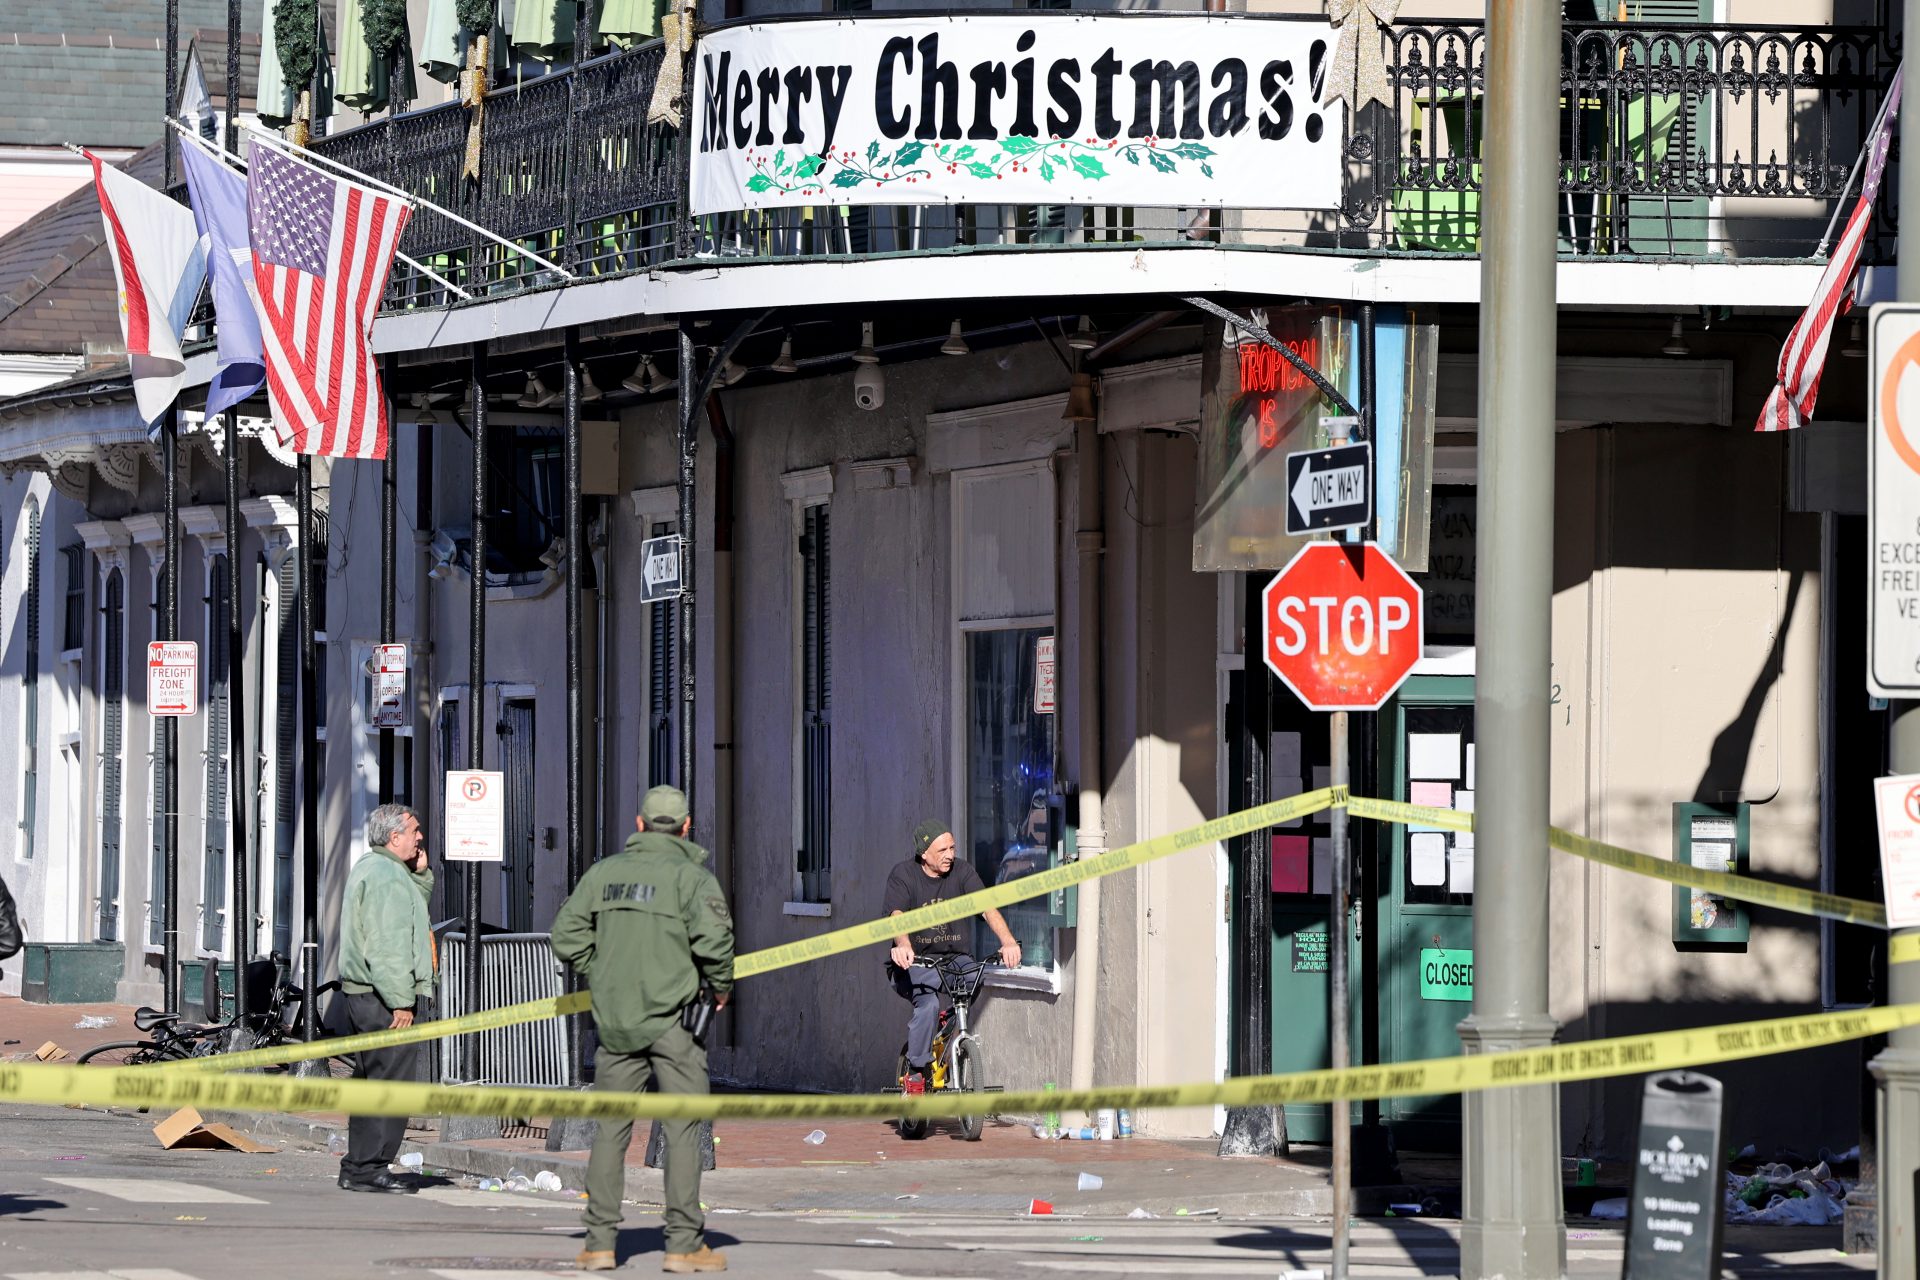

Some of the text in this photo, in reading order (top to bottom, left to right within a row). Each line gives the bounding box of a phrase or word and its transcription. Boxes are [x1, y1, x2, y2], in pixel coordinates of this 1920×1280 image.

[700, 30, 1327, 175] Merry Christmas!
[1312, 470, 1361, 505] ONE WAY
[653, 553, 677, 581] ONE WAY
[1275, 596, 1411, 656] STOP
[149, 646, 195, 662] NO PARKING
[152, 668, 192, 678] FREIGHT
[388, 674, 395, 684] TO
[160, 680, 184, 689] ZONE
[382, 687, 402, 696] CORNER
[382, 711, 402, 721] ANYTIME
[603, 883, 625, 901] LDWF
[1640, 1149, 1709, 1170] BOURBON
[1658, 1198, 1700, 1214] Minute
[1647, 1216, 1693, 1236] Loading
[1653, 1237, 1684, 1253] Zone
